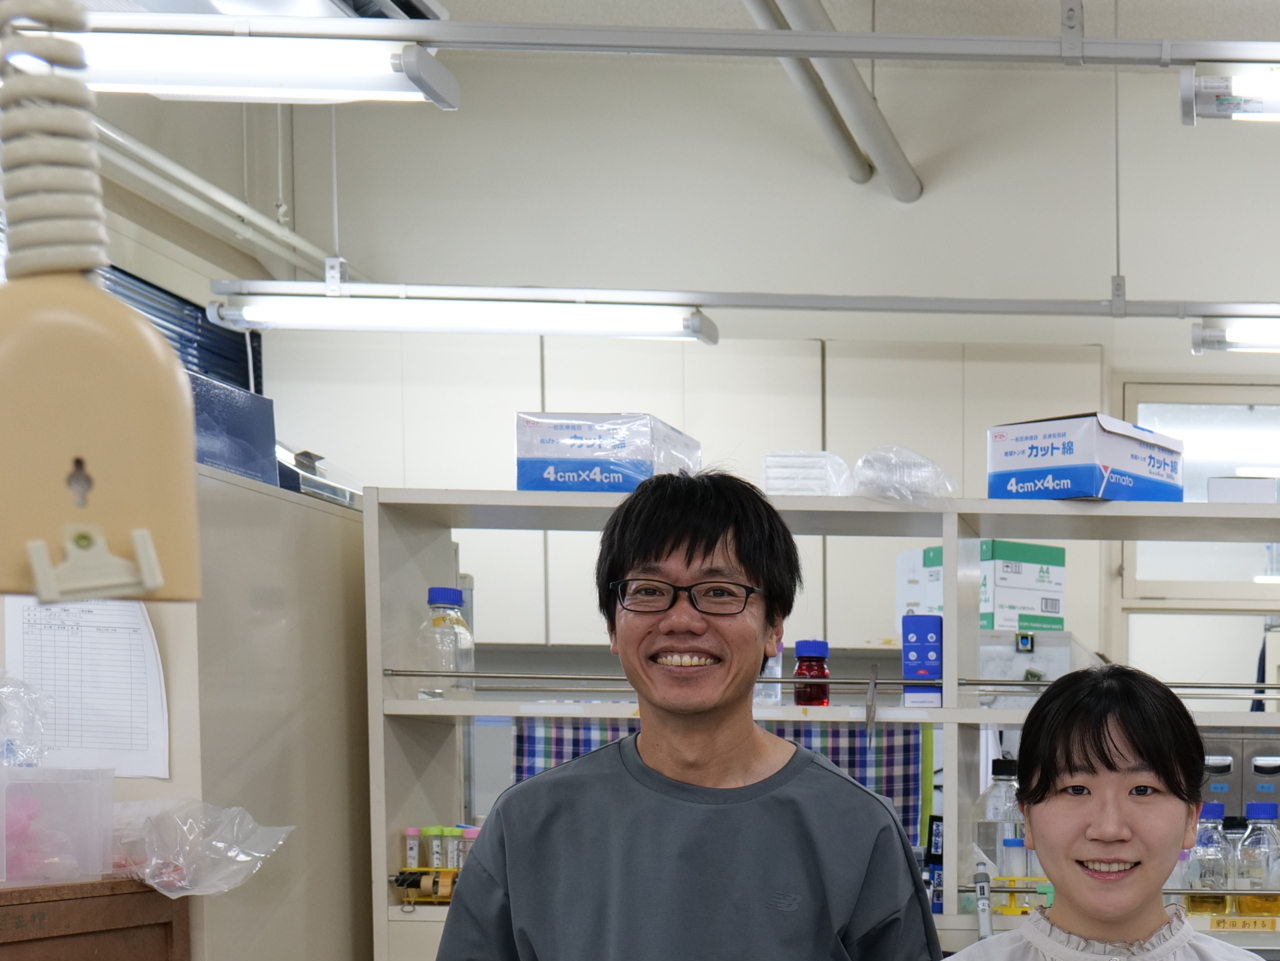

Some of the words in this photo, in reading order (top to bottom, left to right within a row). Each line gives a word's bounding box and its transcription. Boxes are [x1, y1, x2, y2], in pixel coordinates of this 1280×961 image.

[1028, 441, 1074, 458] カット綿
[1147, 454, 1178, 475] カット綿
[1039, 565, 1050, 575] A4
